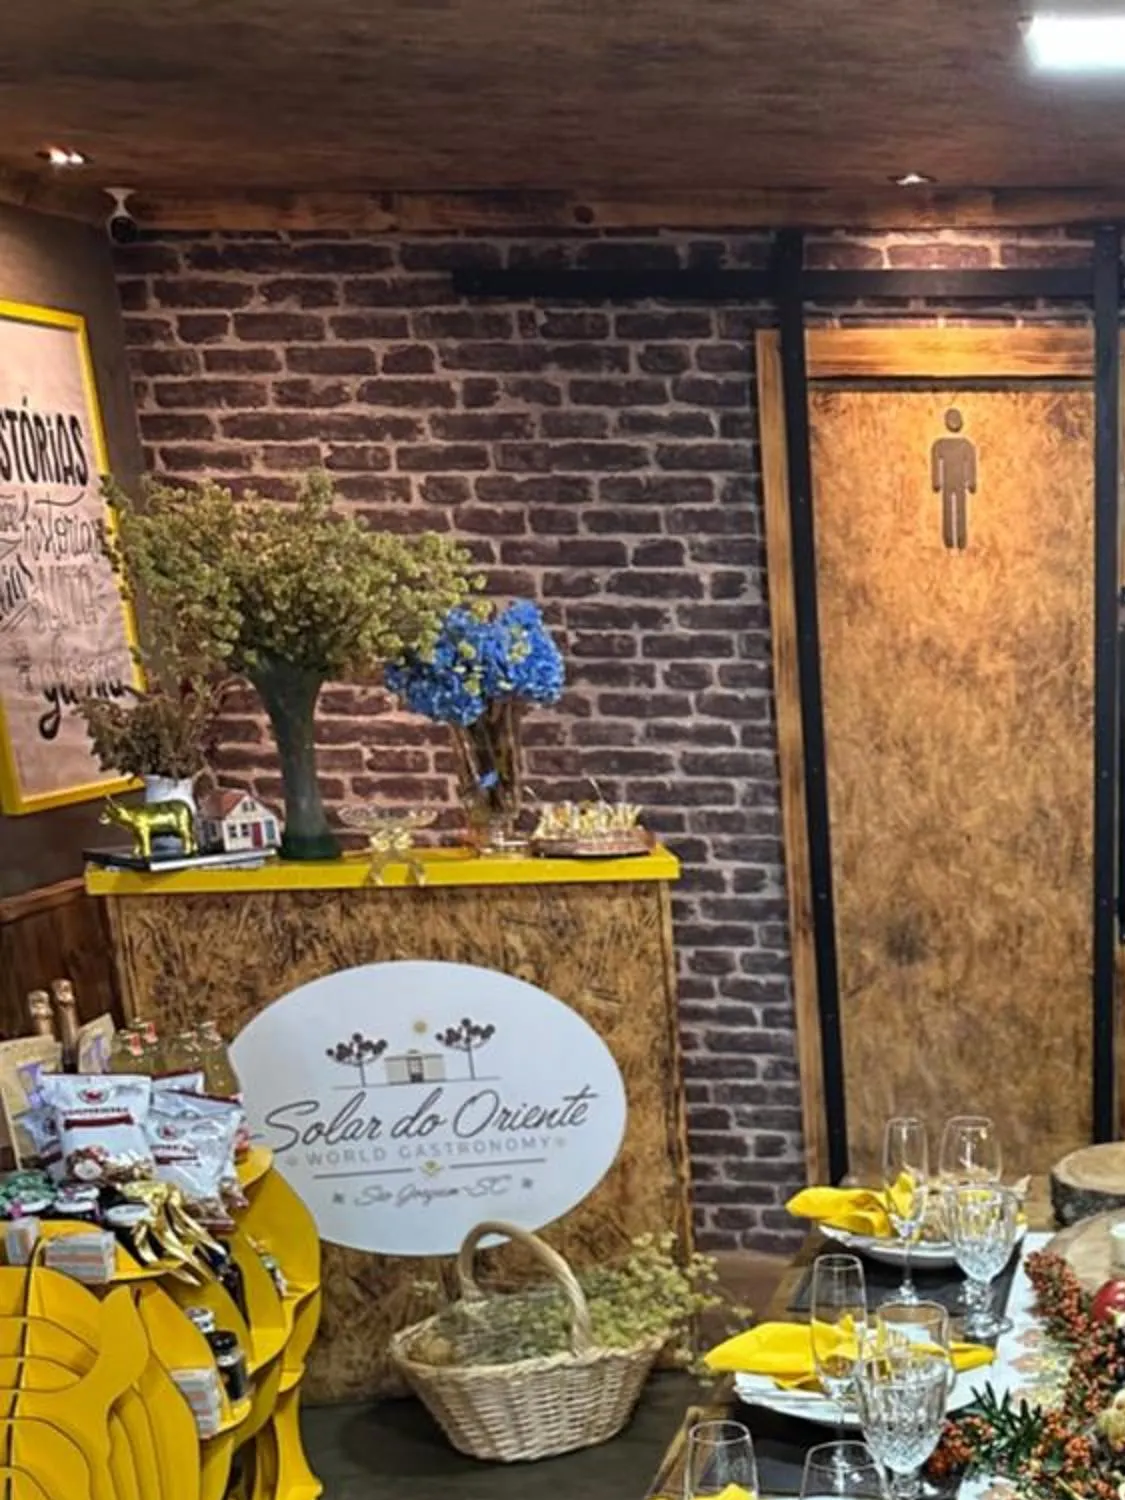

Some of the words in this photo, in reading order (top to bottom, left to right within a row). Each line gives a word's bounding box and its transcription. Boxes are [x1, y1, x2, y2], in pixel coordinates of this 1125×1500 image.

[256, 1091, 382, 1153] Solar
[391, 1086, 447, 1139] do
[453, 1085, 598, 1139] Oriente
[306, 1147, 386, 1166] WORLD
[399, 1135, 551, 1160] GASTRONOMY
